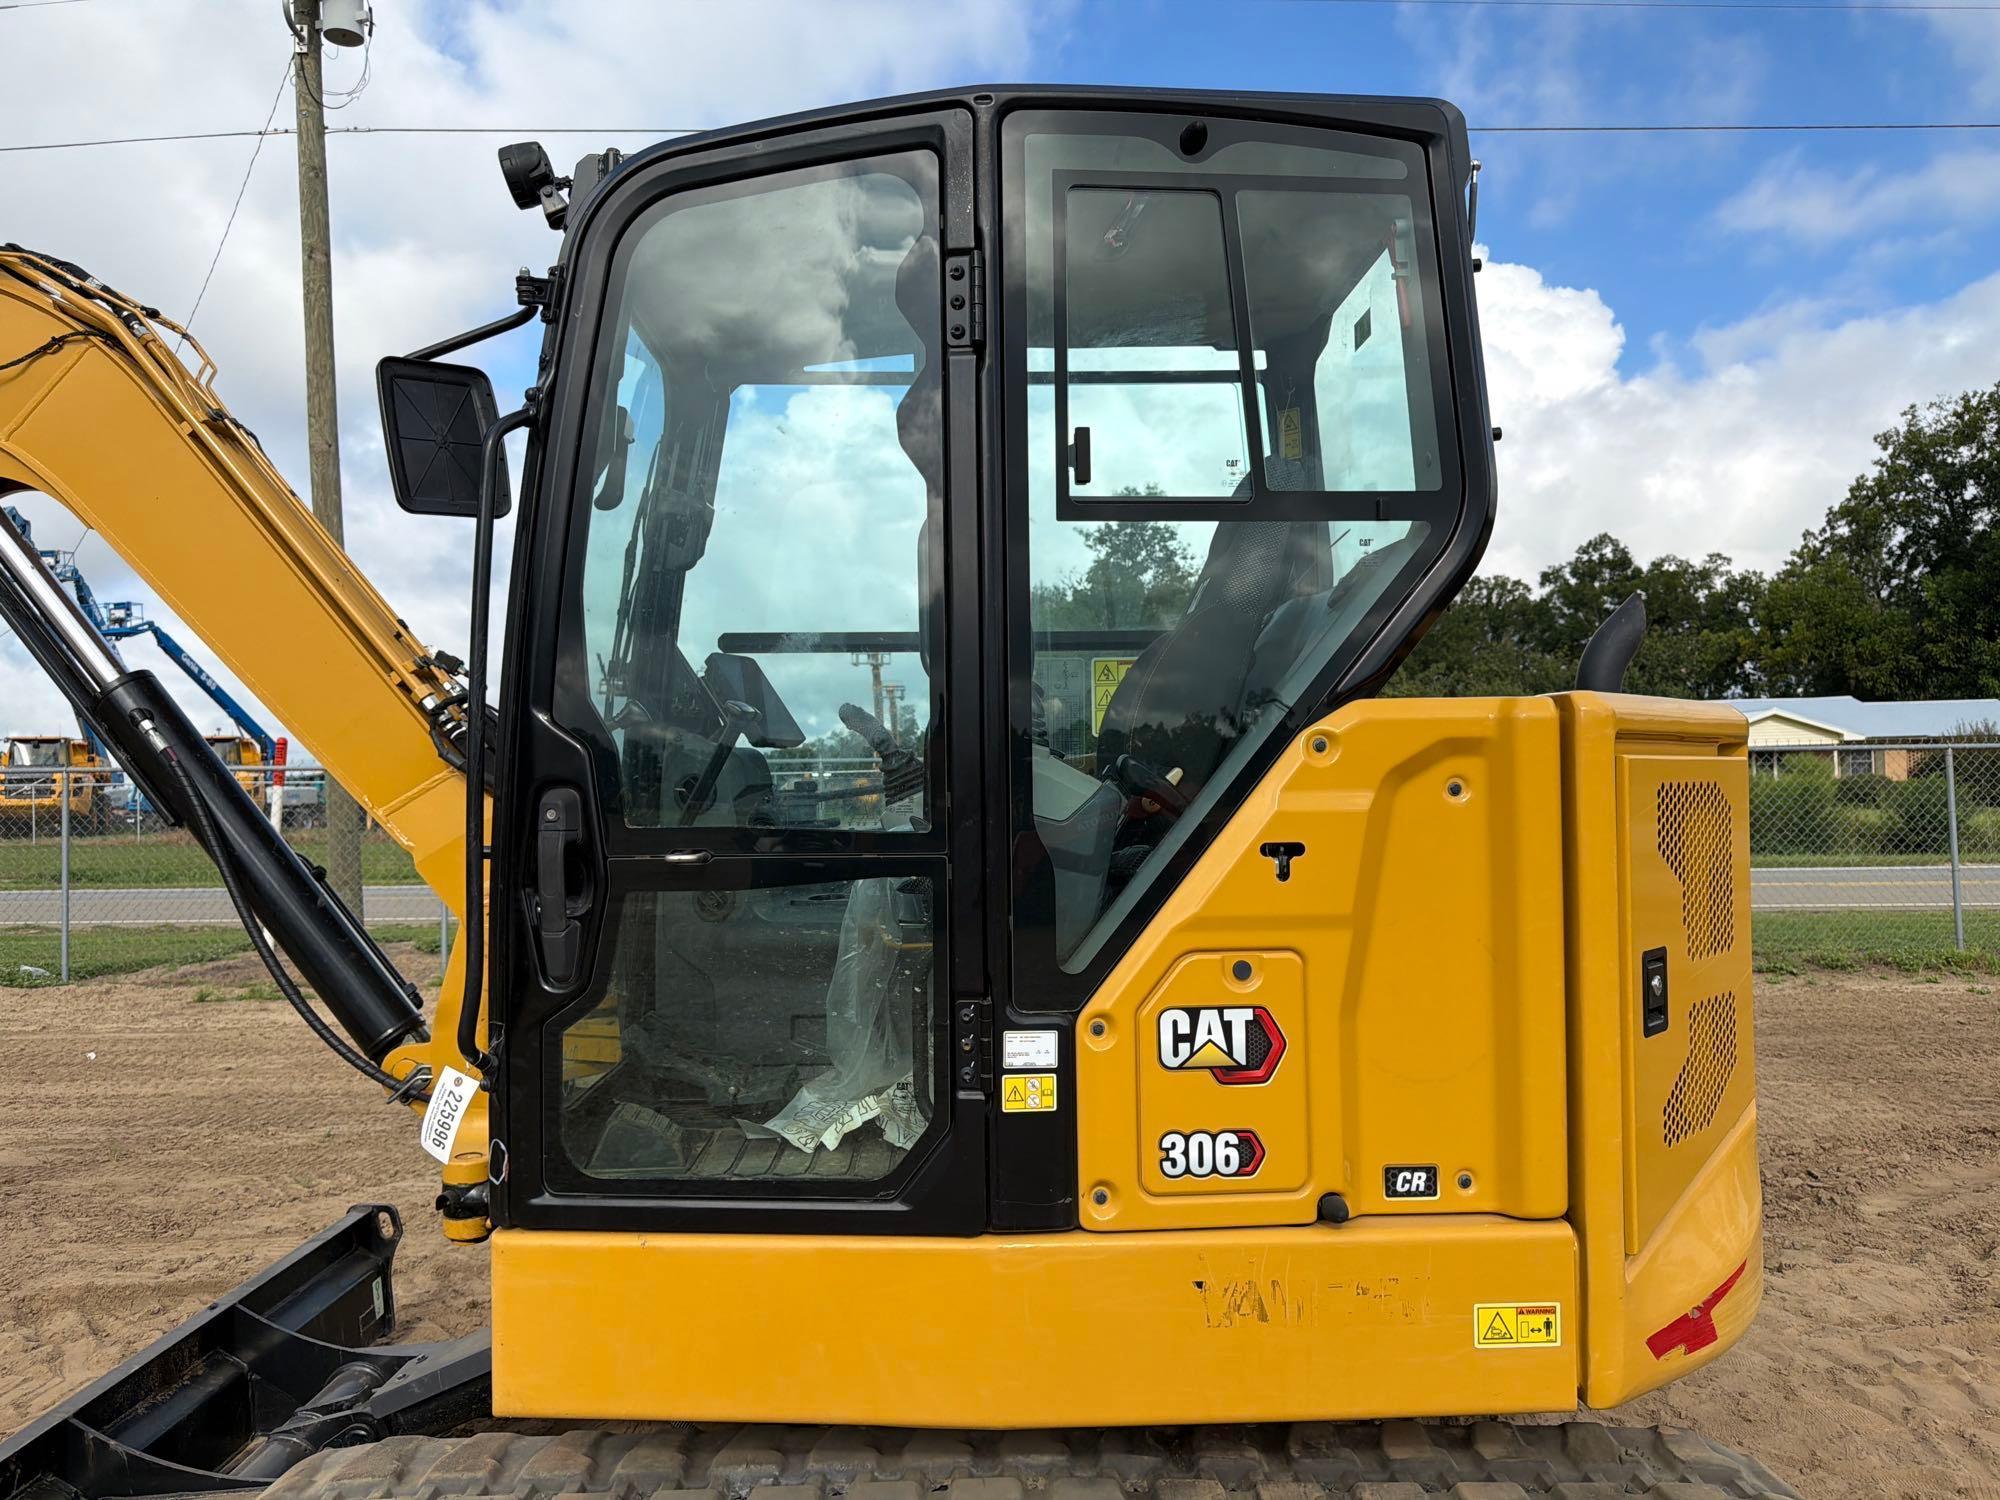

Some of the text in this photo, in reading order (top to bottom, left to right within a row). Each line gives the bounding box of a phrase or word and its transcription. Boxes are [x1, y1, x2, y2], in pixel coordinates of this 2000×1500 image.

[1226, 459, 1239, 467] CAT
[1359, 538, 1371, 546] CAT
[1159, 1007, 1254, 1068] CAT
[432, 1090, 463, 1150] 225996
[1160, 1131, 1240, 1176] 306
[1396, 1171, 1427, 1192] CR
